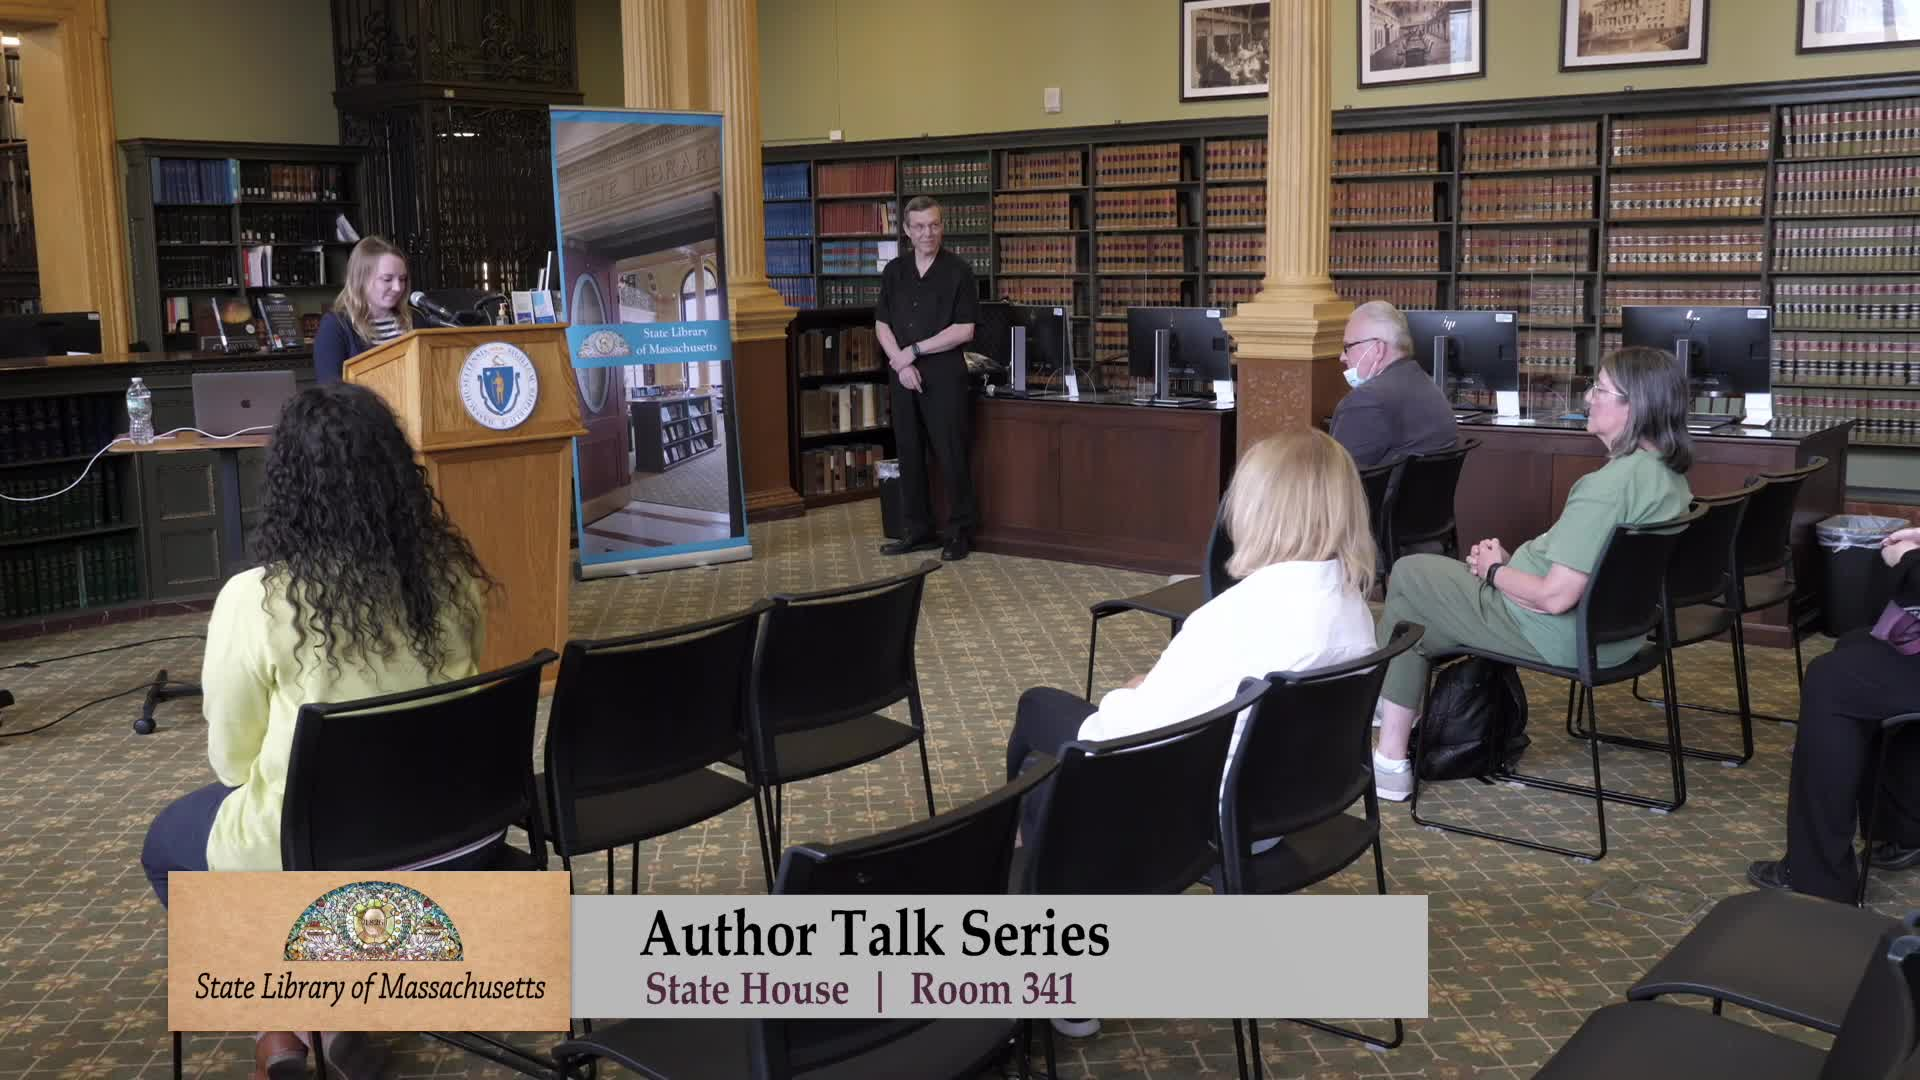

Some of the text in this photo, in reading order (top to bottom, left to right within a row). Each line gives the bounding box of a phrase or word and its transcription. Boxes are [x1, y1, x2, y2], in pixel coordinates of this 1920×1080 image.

[643, 326, 708, 339] State Library
[636, 341, 718, 355] of Massachusetts
